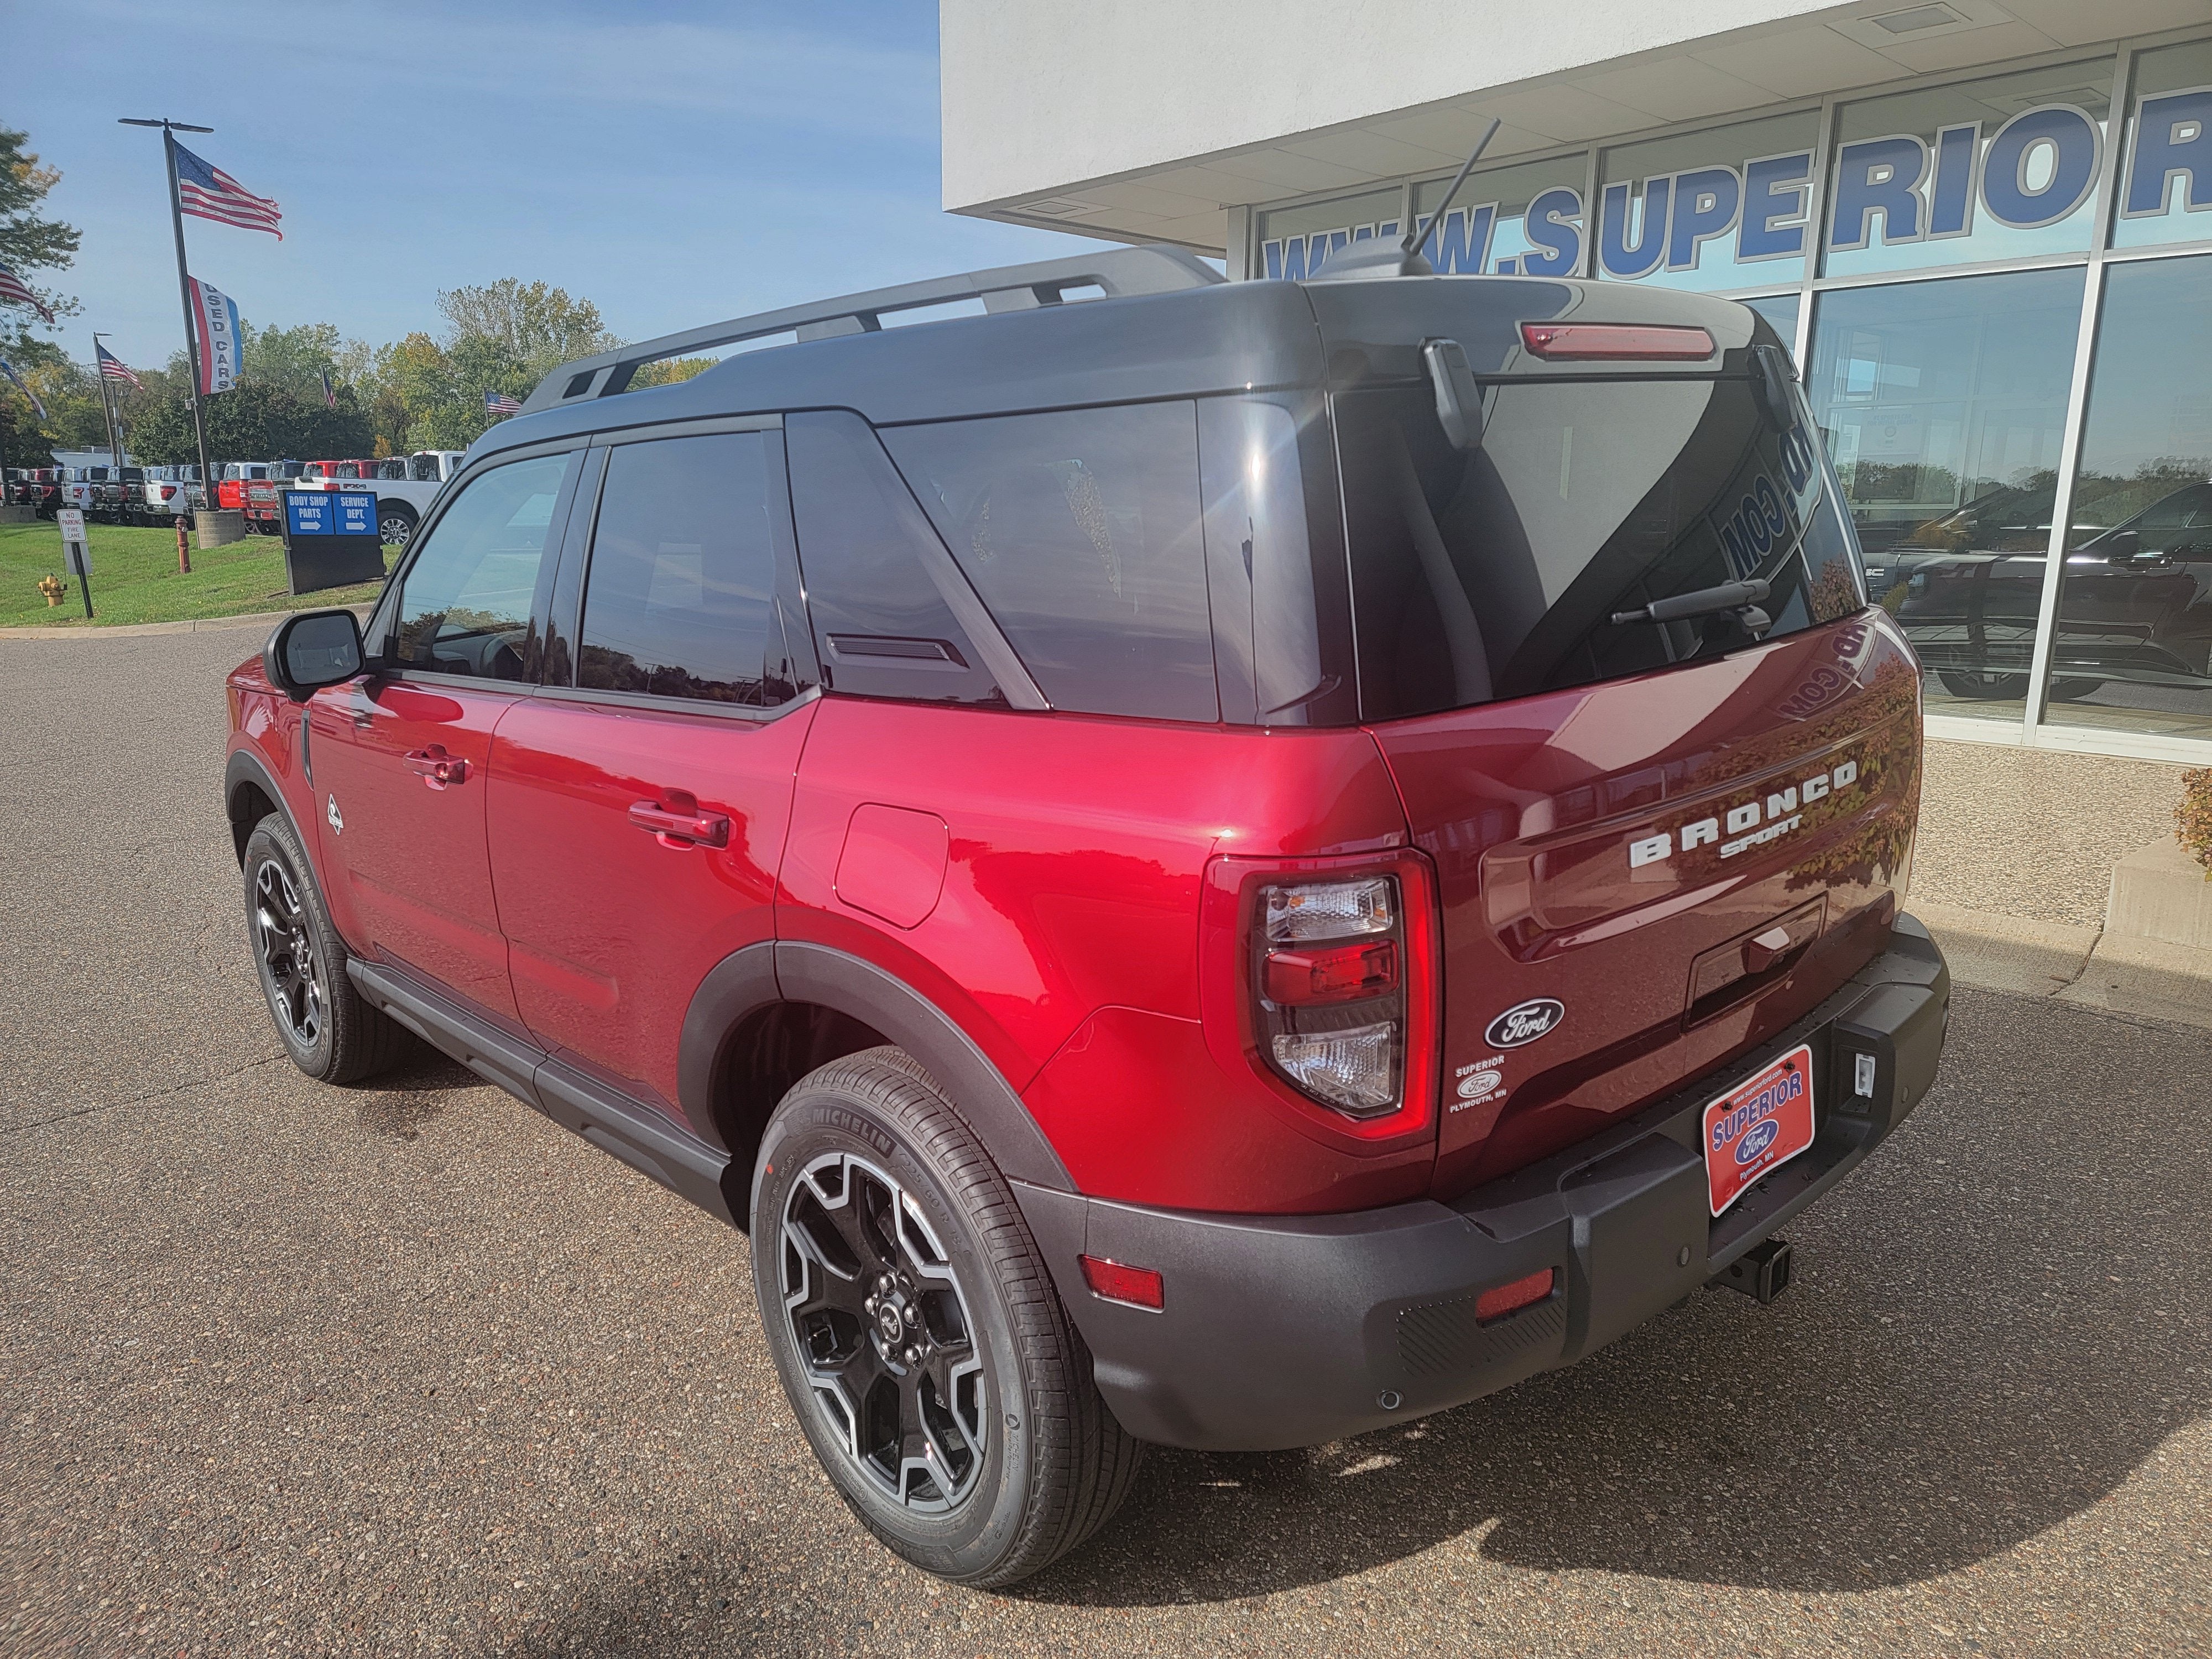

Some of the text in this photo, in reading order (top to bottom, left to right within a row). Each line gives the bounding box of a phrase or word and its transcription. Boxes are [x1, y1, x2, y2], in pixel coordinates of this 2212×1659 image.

[205, 284, 230, 389] USED CARS
[289, 495, 328, 507] BODY SHOP
[299, 508, 321, 519] PARTS
[341, 497, 369, 507] SERVICE
[347, 509, 365, 519] DEPT.
[1630, 760, 1857, 869] BRONCO
[1720, 814, 1803, 859] SPORT
[1501, 1006, 1552, 1042] Ford
[1455, 1055, 1505, 1078] SUPERIOR
[1449, 1089, 1507, 1113] PLYMOUTH, MN
[1468, 1078, 1493, 1093] Ford
[1733, 1069, 1782, 1105] www.superiorford.com
[1713, 1071, 1803, 1152] SUPERIOR
[812, 1108, 891, 1152] MICHELIN
[1743, 1126, 1770, 1159] Ford
[1740, 1160, 1765, 1182] Plymouth,
[1765, 1150, 1774, 1162] MN
[901, 1160, 940, 1208] 225/60
